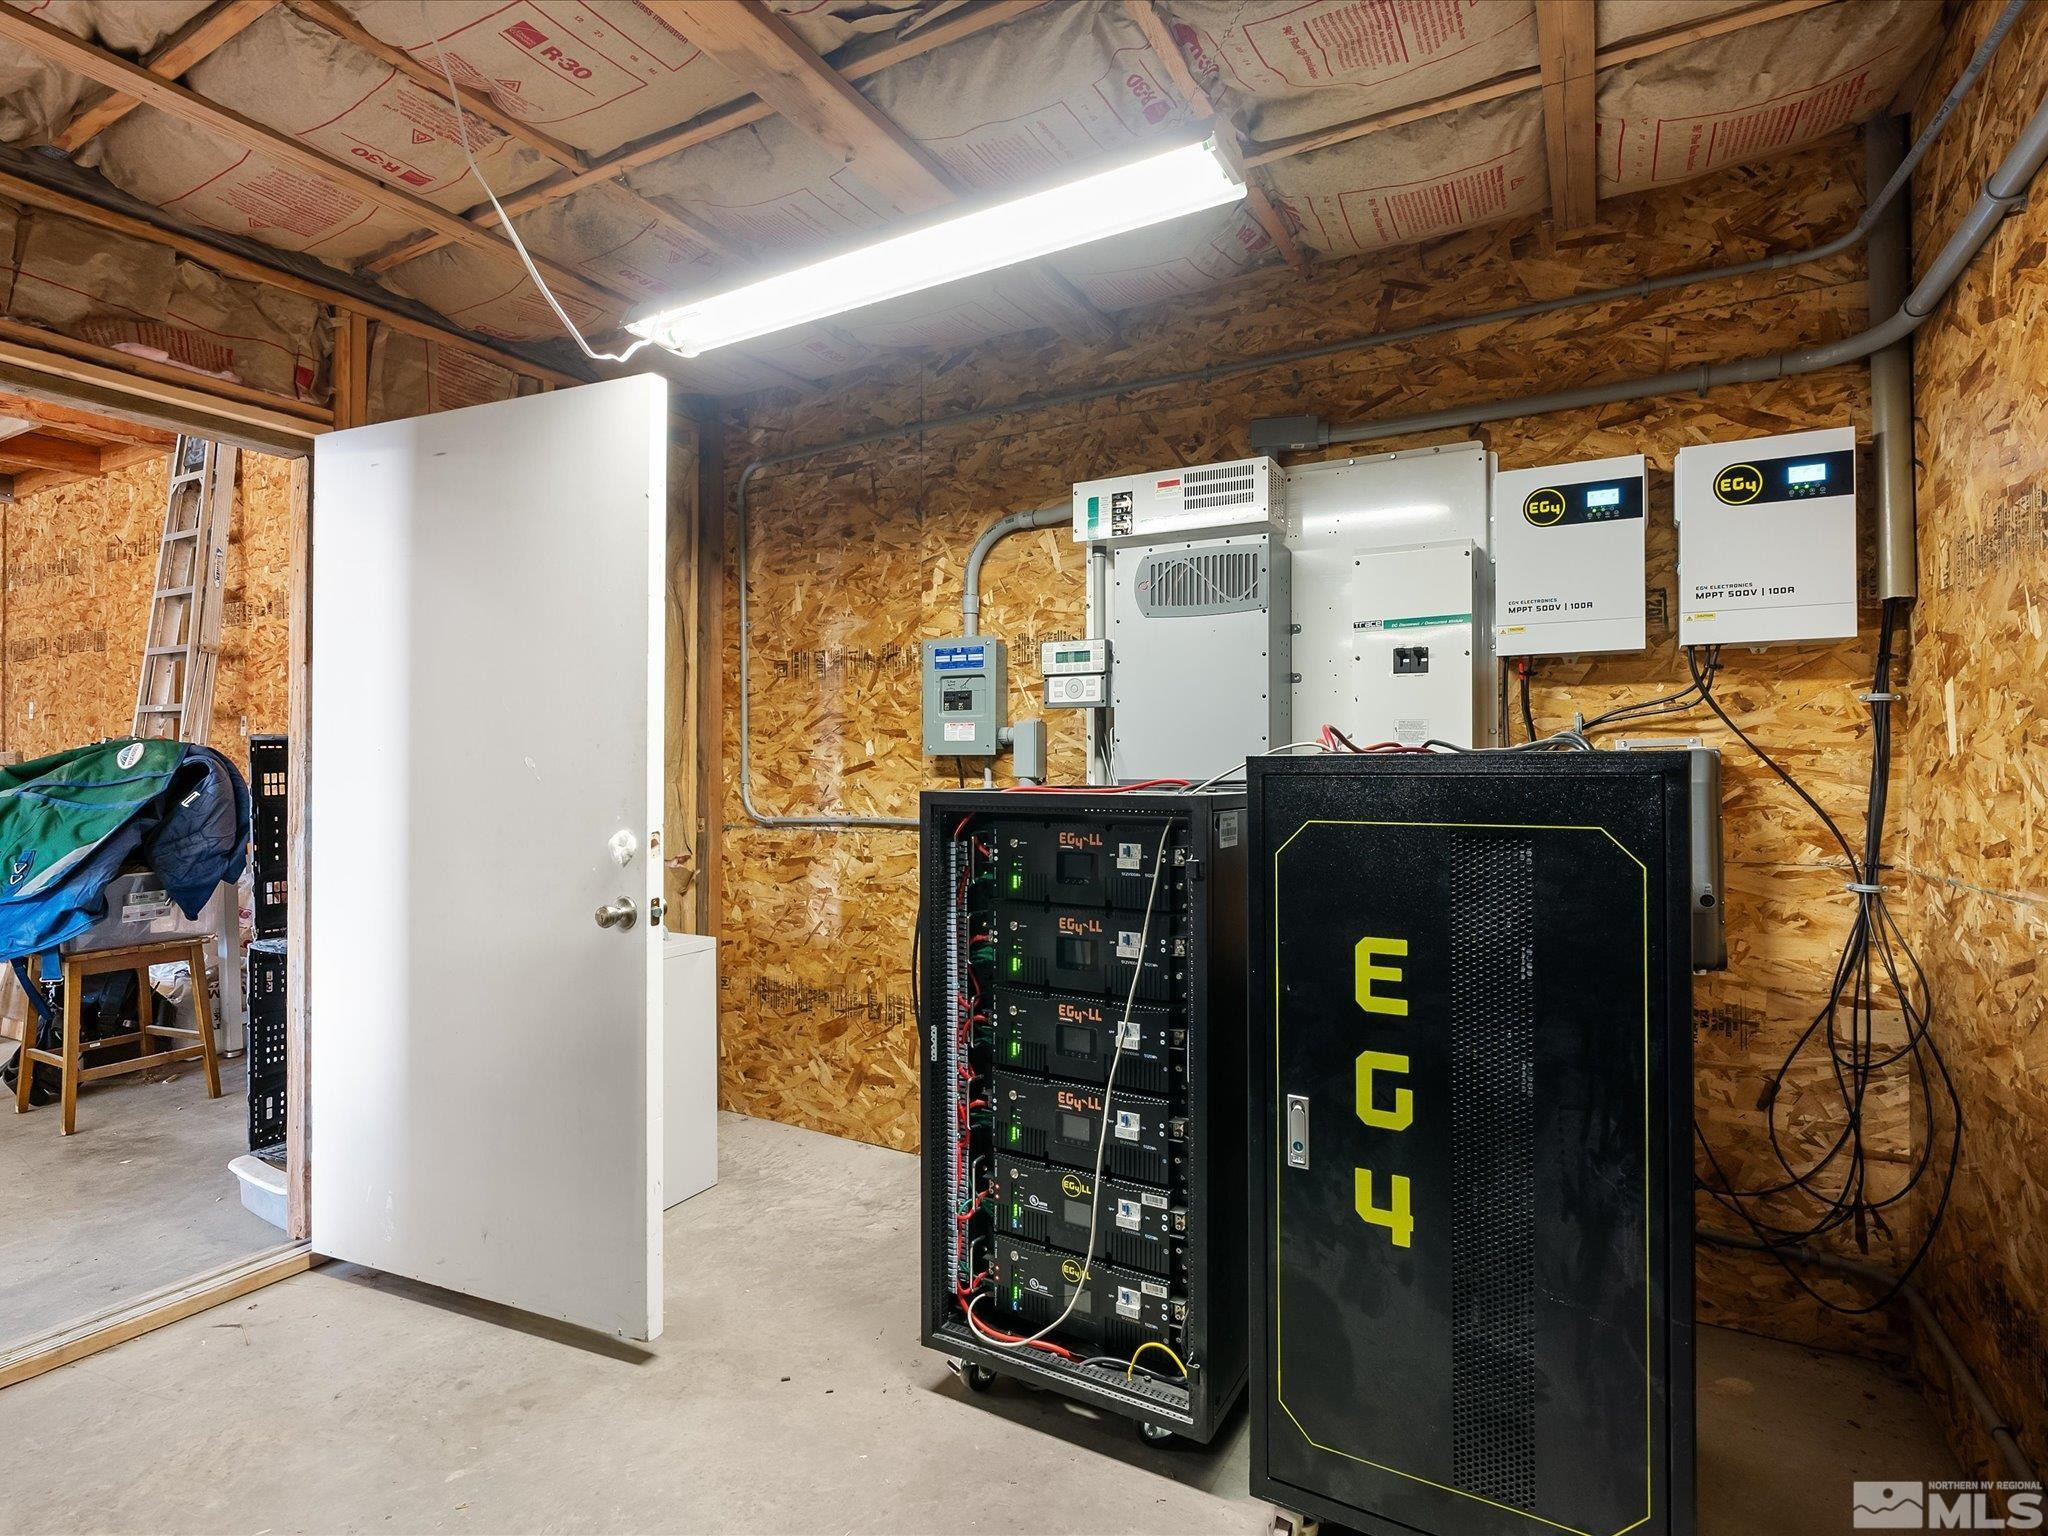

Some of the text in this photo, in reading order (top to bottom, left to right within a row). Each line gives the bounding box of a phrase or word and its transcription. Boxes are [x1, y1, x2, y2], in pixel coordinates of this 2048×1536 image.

[540, 45, 592, 79] R-30
[350, 147, 401, 173] R-30
[1720, 477, 1757, 492] EG4
[1529, 501, 1560, 514] EG4
[1695, 591, 1724, 600] MPPT
[1728, 589, 1758, 598] 500V
[1768, 586, 1795, 595] 100A
[1709, 582, 1753, 590] ELECTRONICS
[1508, 605, 1533, 614] MPPT
[1536, 604, 1561, 612] 500V
[1570, 601, 1593, 610] 100A
